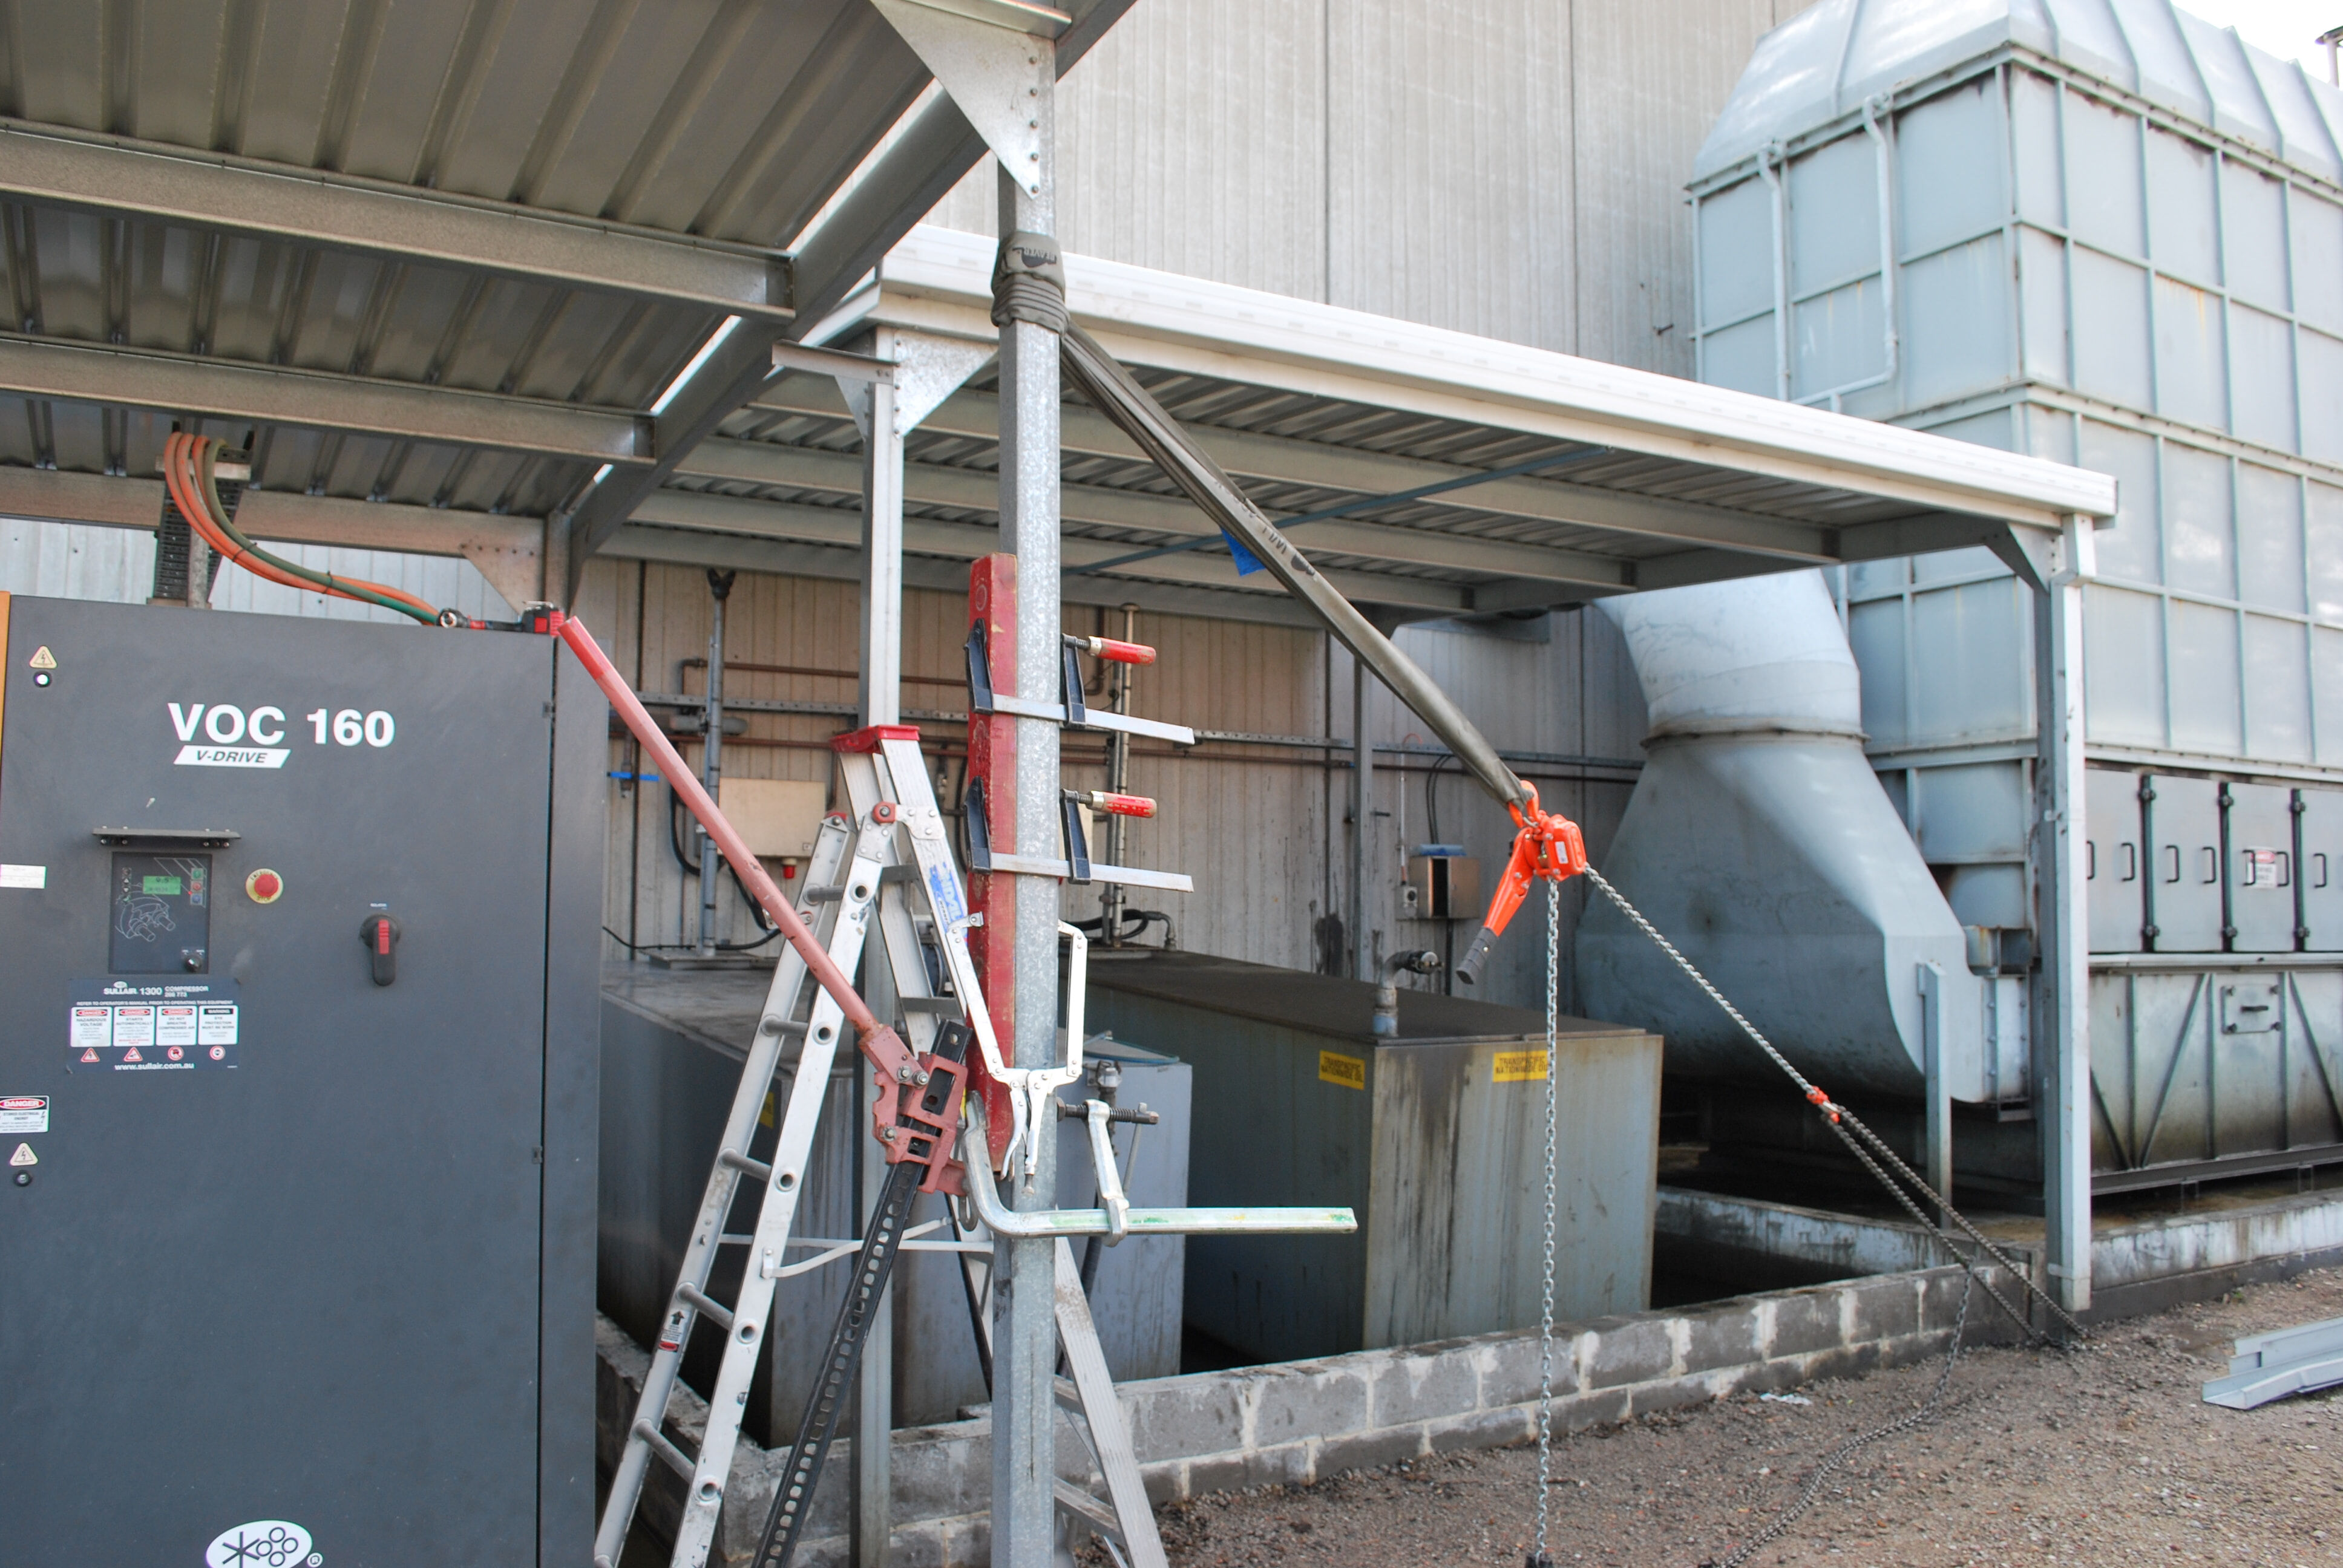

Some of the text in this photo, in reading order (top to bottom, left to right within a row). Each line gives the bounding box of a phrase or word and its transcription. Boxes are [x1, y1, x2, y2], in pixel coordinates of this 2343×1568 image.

[1023, 247, 1056, 261] BEAVER
[167, 702, 396, 748] VOC 160
[196, 750, 268, 763] V-DRIVE
[139, 987, 163, 996] 1300
[114, 1062, 195, 1071] www.sullair.com.au
